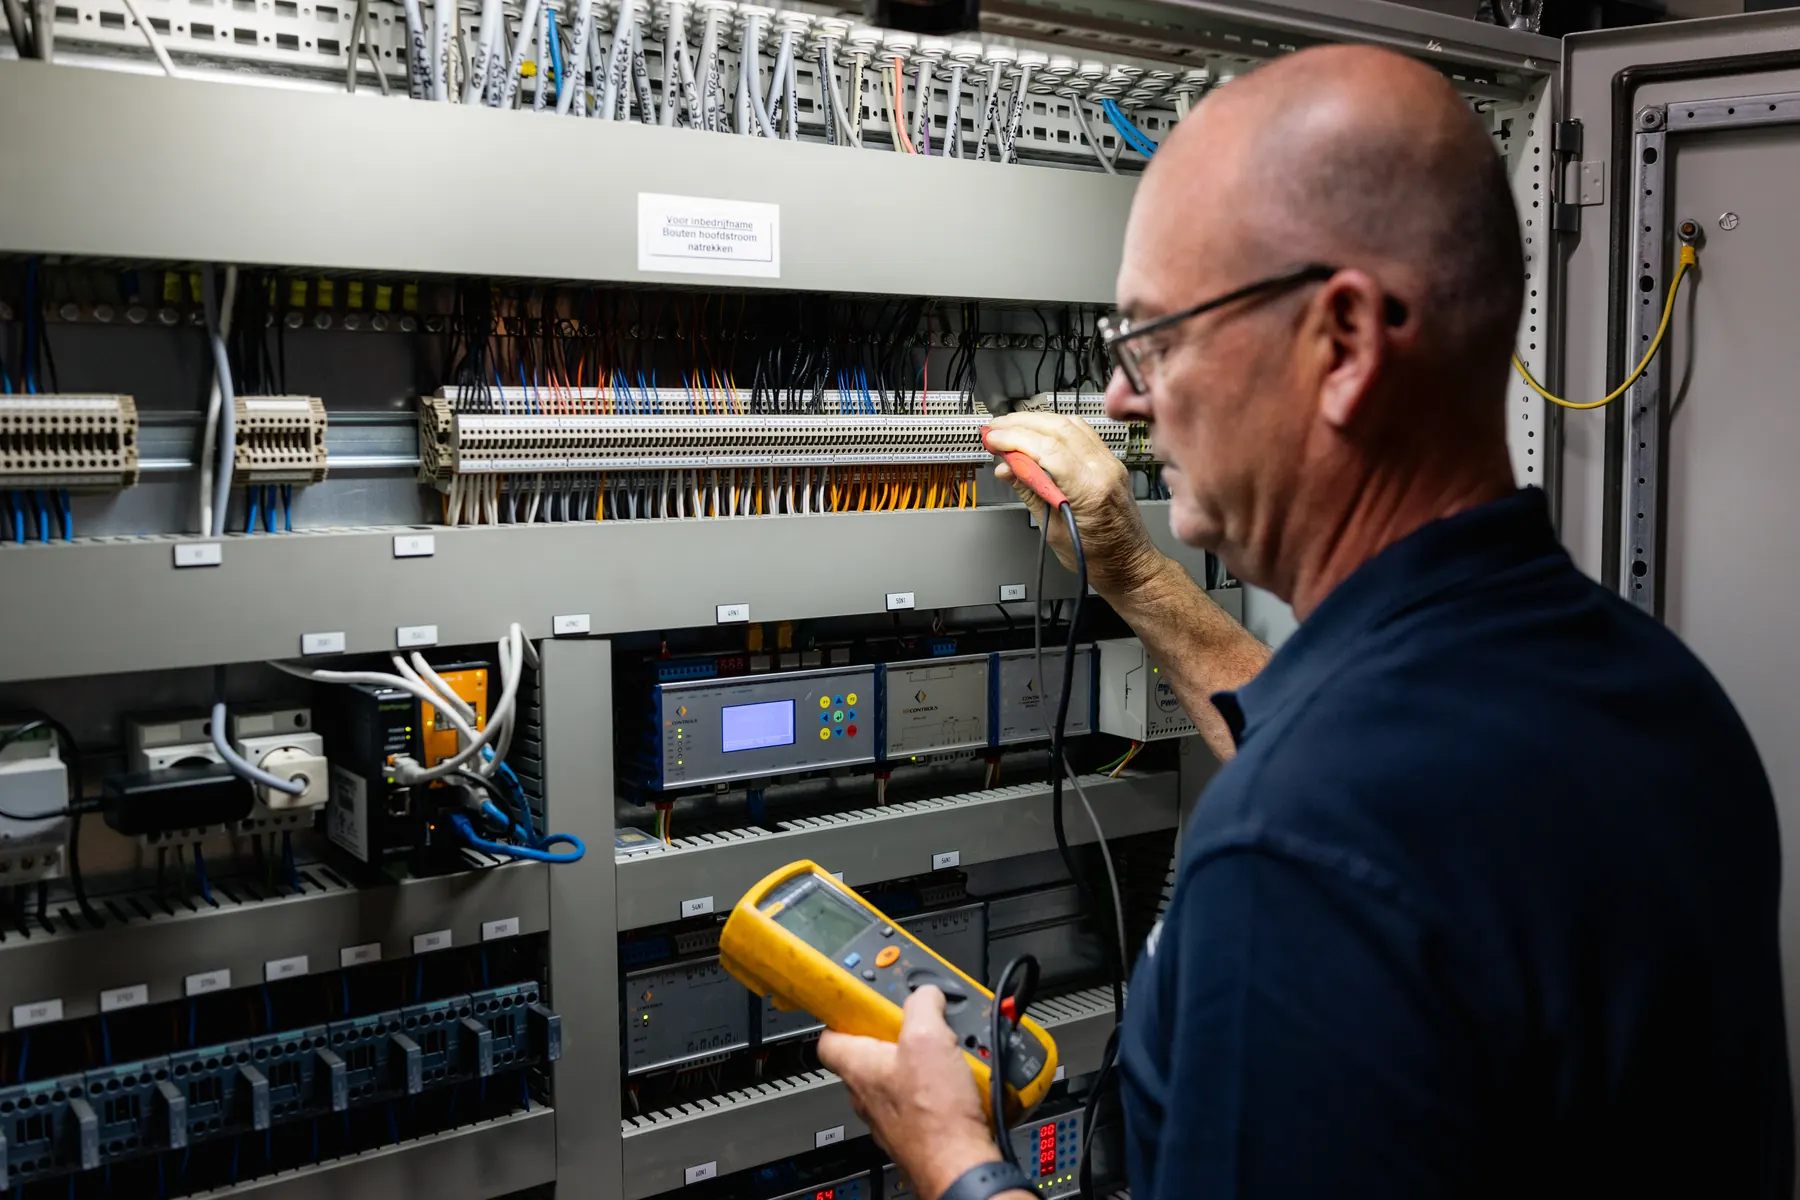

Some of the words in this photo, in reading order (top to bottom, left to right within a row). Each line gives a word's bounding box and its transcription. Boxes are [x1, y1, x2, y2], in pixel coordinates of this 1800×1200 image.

[666, 215, 689, 225] Voor
[691, 217, 753, 230] inbedrijfname
[662, 227, 696, 238] Bouten
[699, 231, 757, 242] hoofdstroom
[688, 243, 733, 253] natrekken
